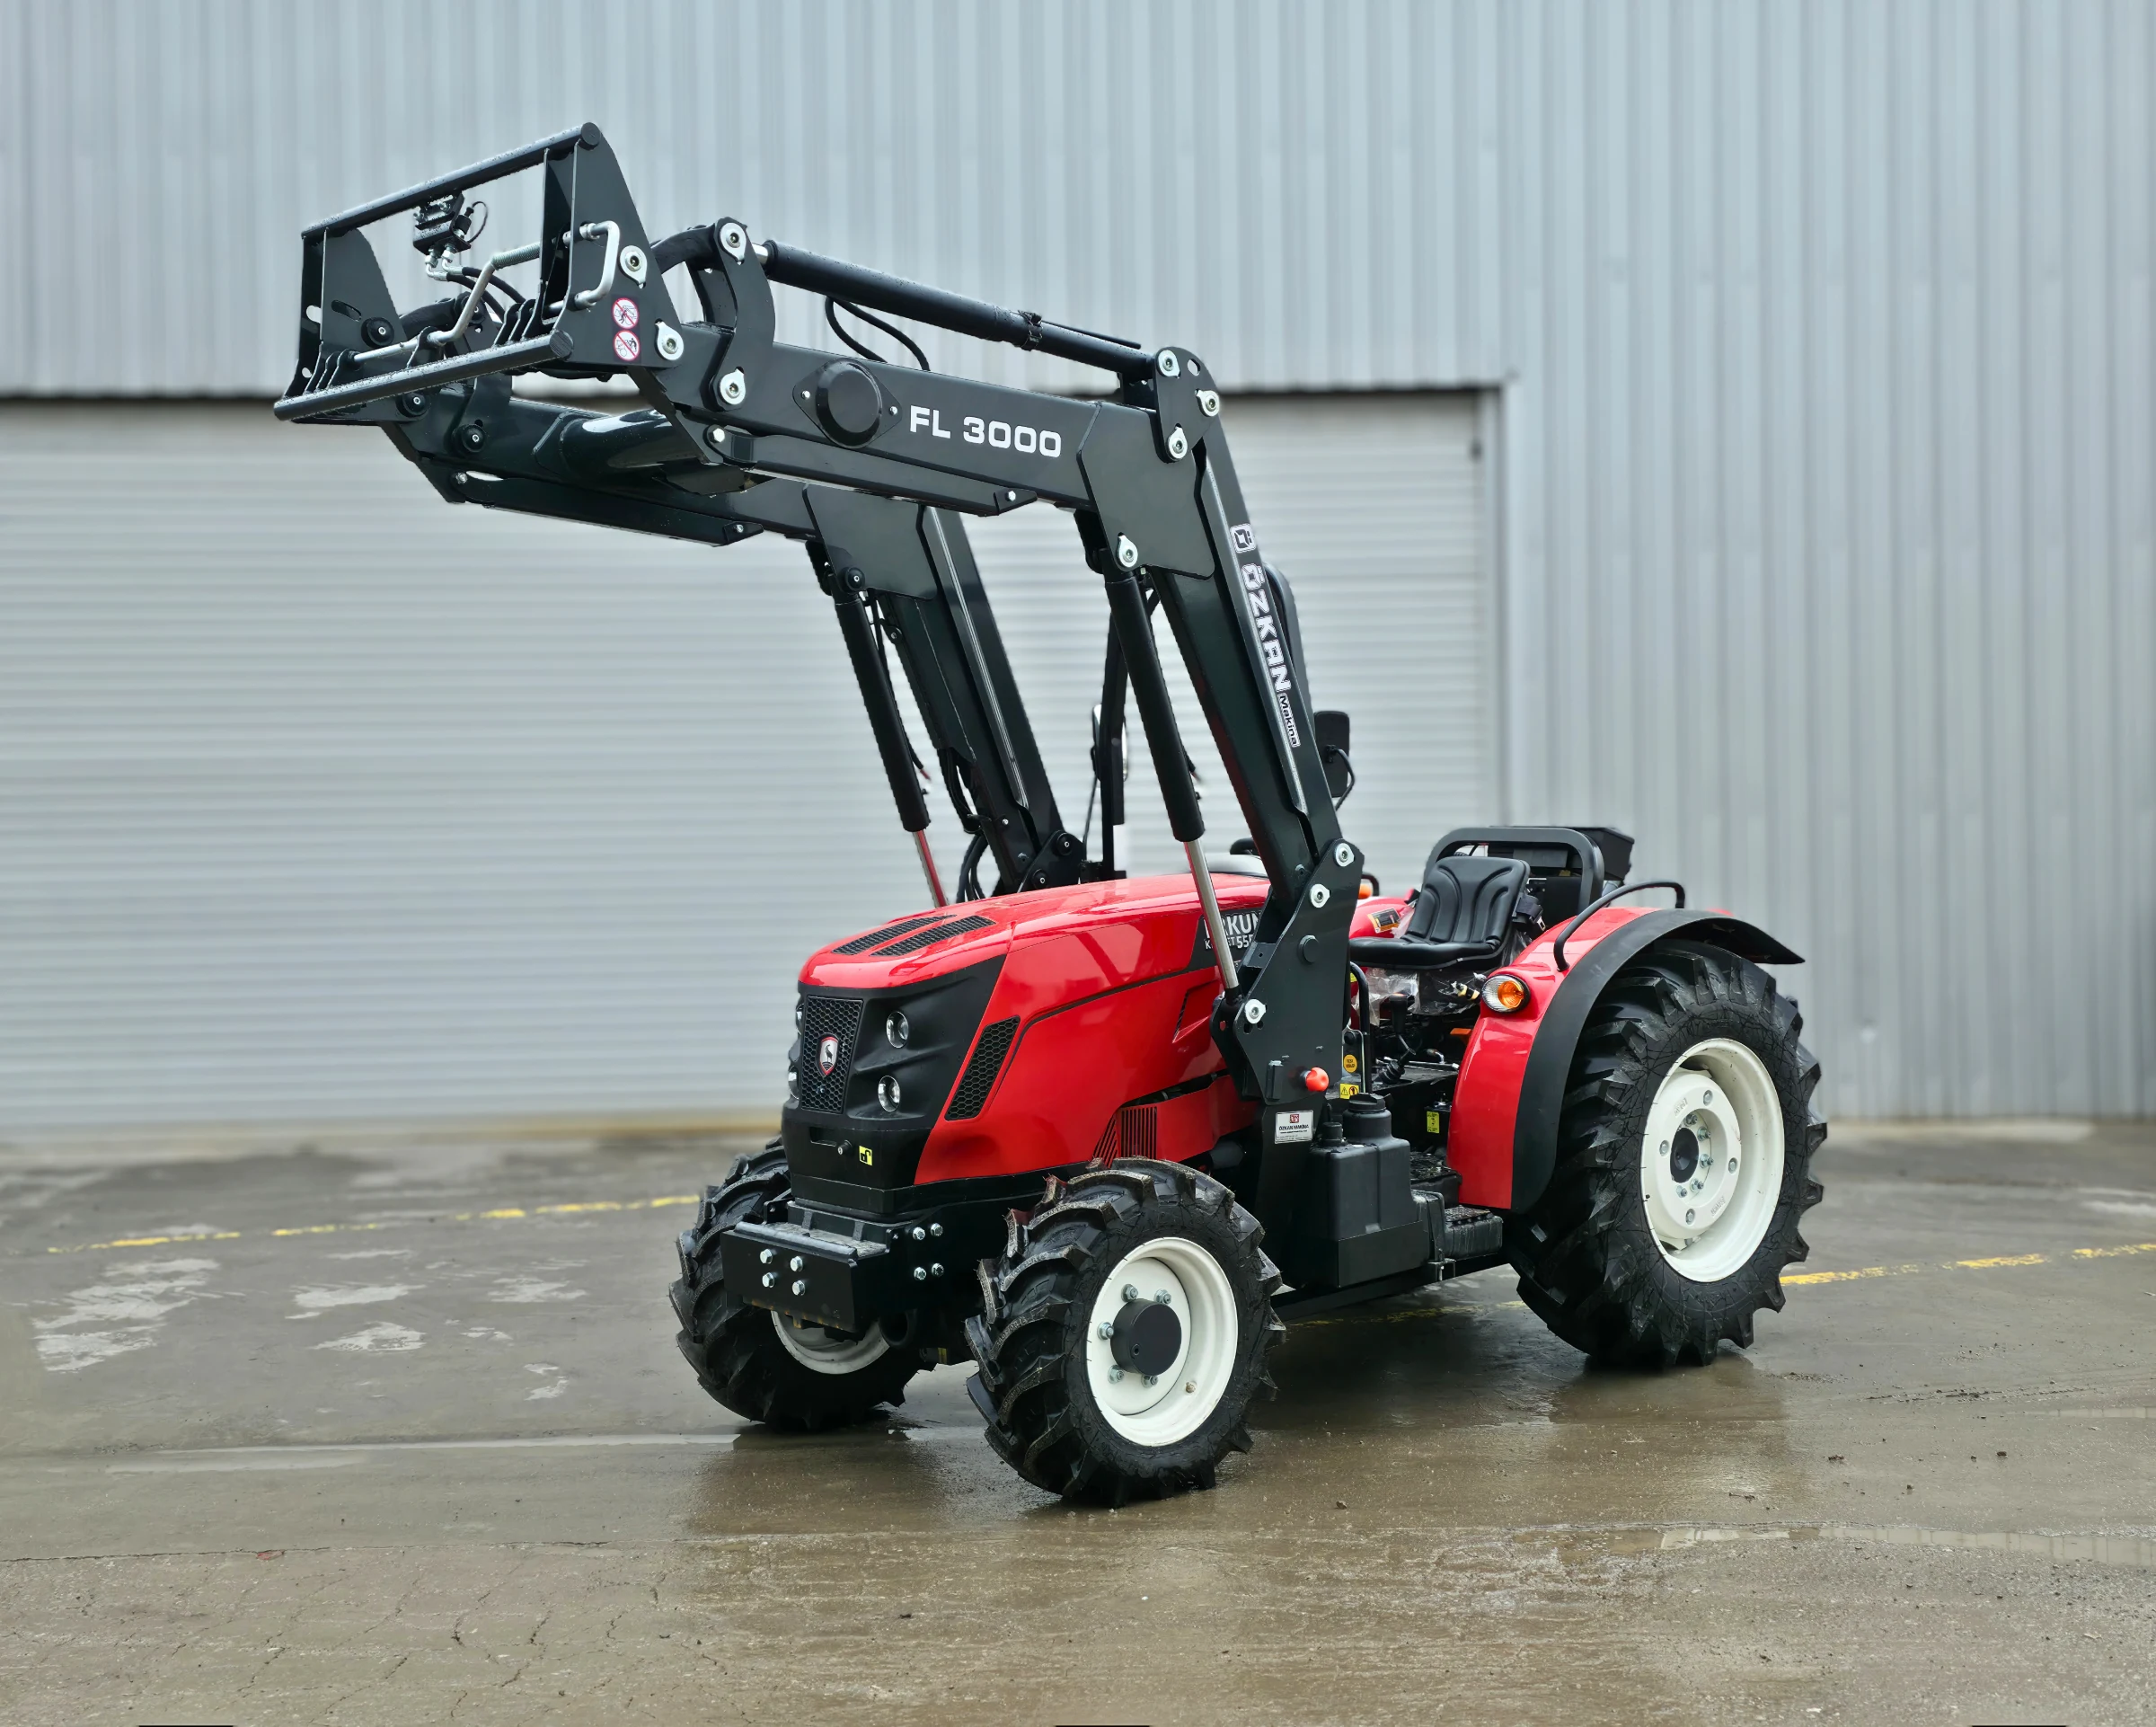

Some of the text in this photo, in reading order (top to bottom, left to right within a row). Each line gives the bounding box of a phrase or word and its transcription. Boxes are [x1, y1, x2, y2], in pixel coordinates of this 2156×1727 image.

[910, 405, 1061, 457] FL 3000
[1241, 563, 1299, 746] ÖZKAN Makina
